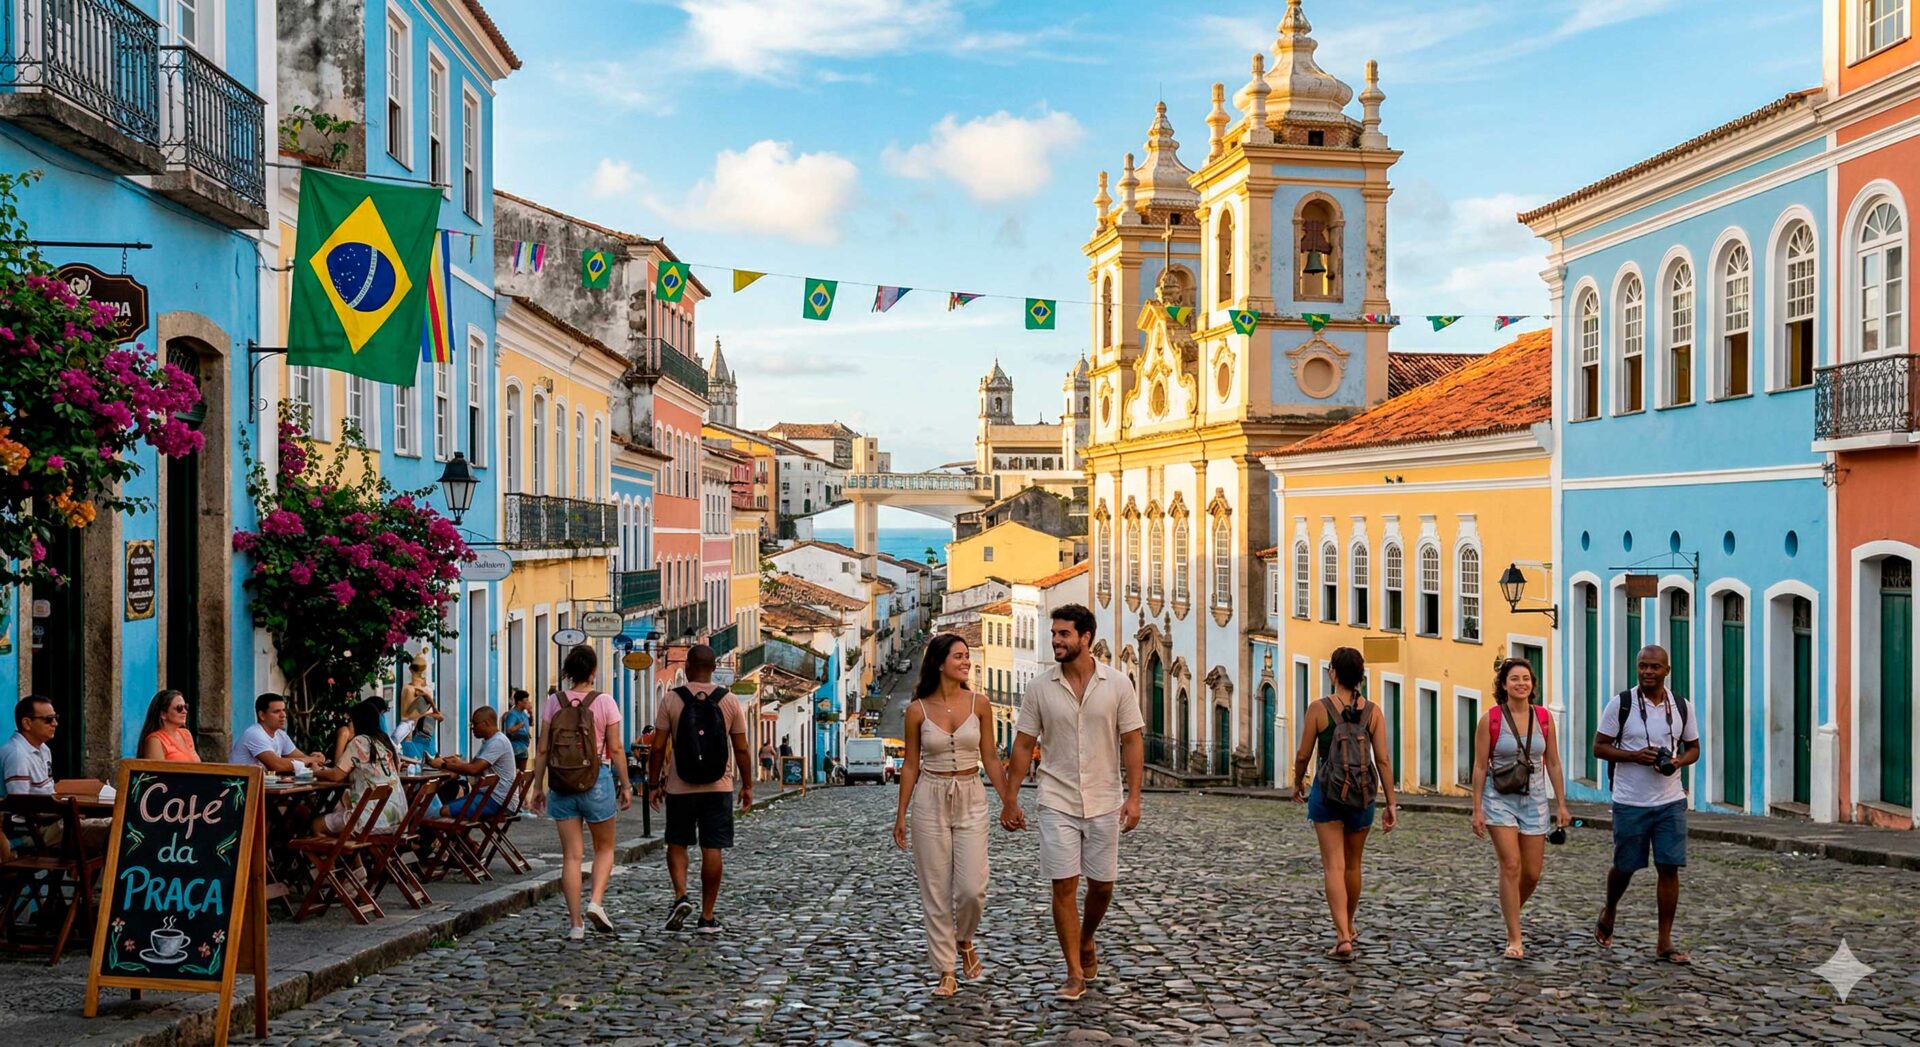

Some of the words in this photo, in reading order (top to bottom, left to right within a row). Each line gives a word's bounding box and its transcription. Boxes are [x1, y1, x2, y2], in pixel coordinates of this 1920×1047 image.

[140, 783, 230, 839] Café
[158, 832, 199, 864] da
[120, 865, 224, 919] PRAÇA
